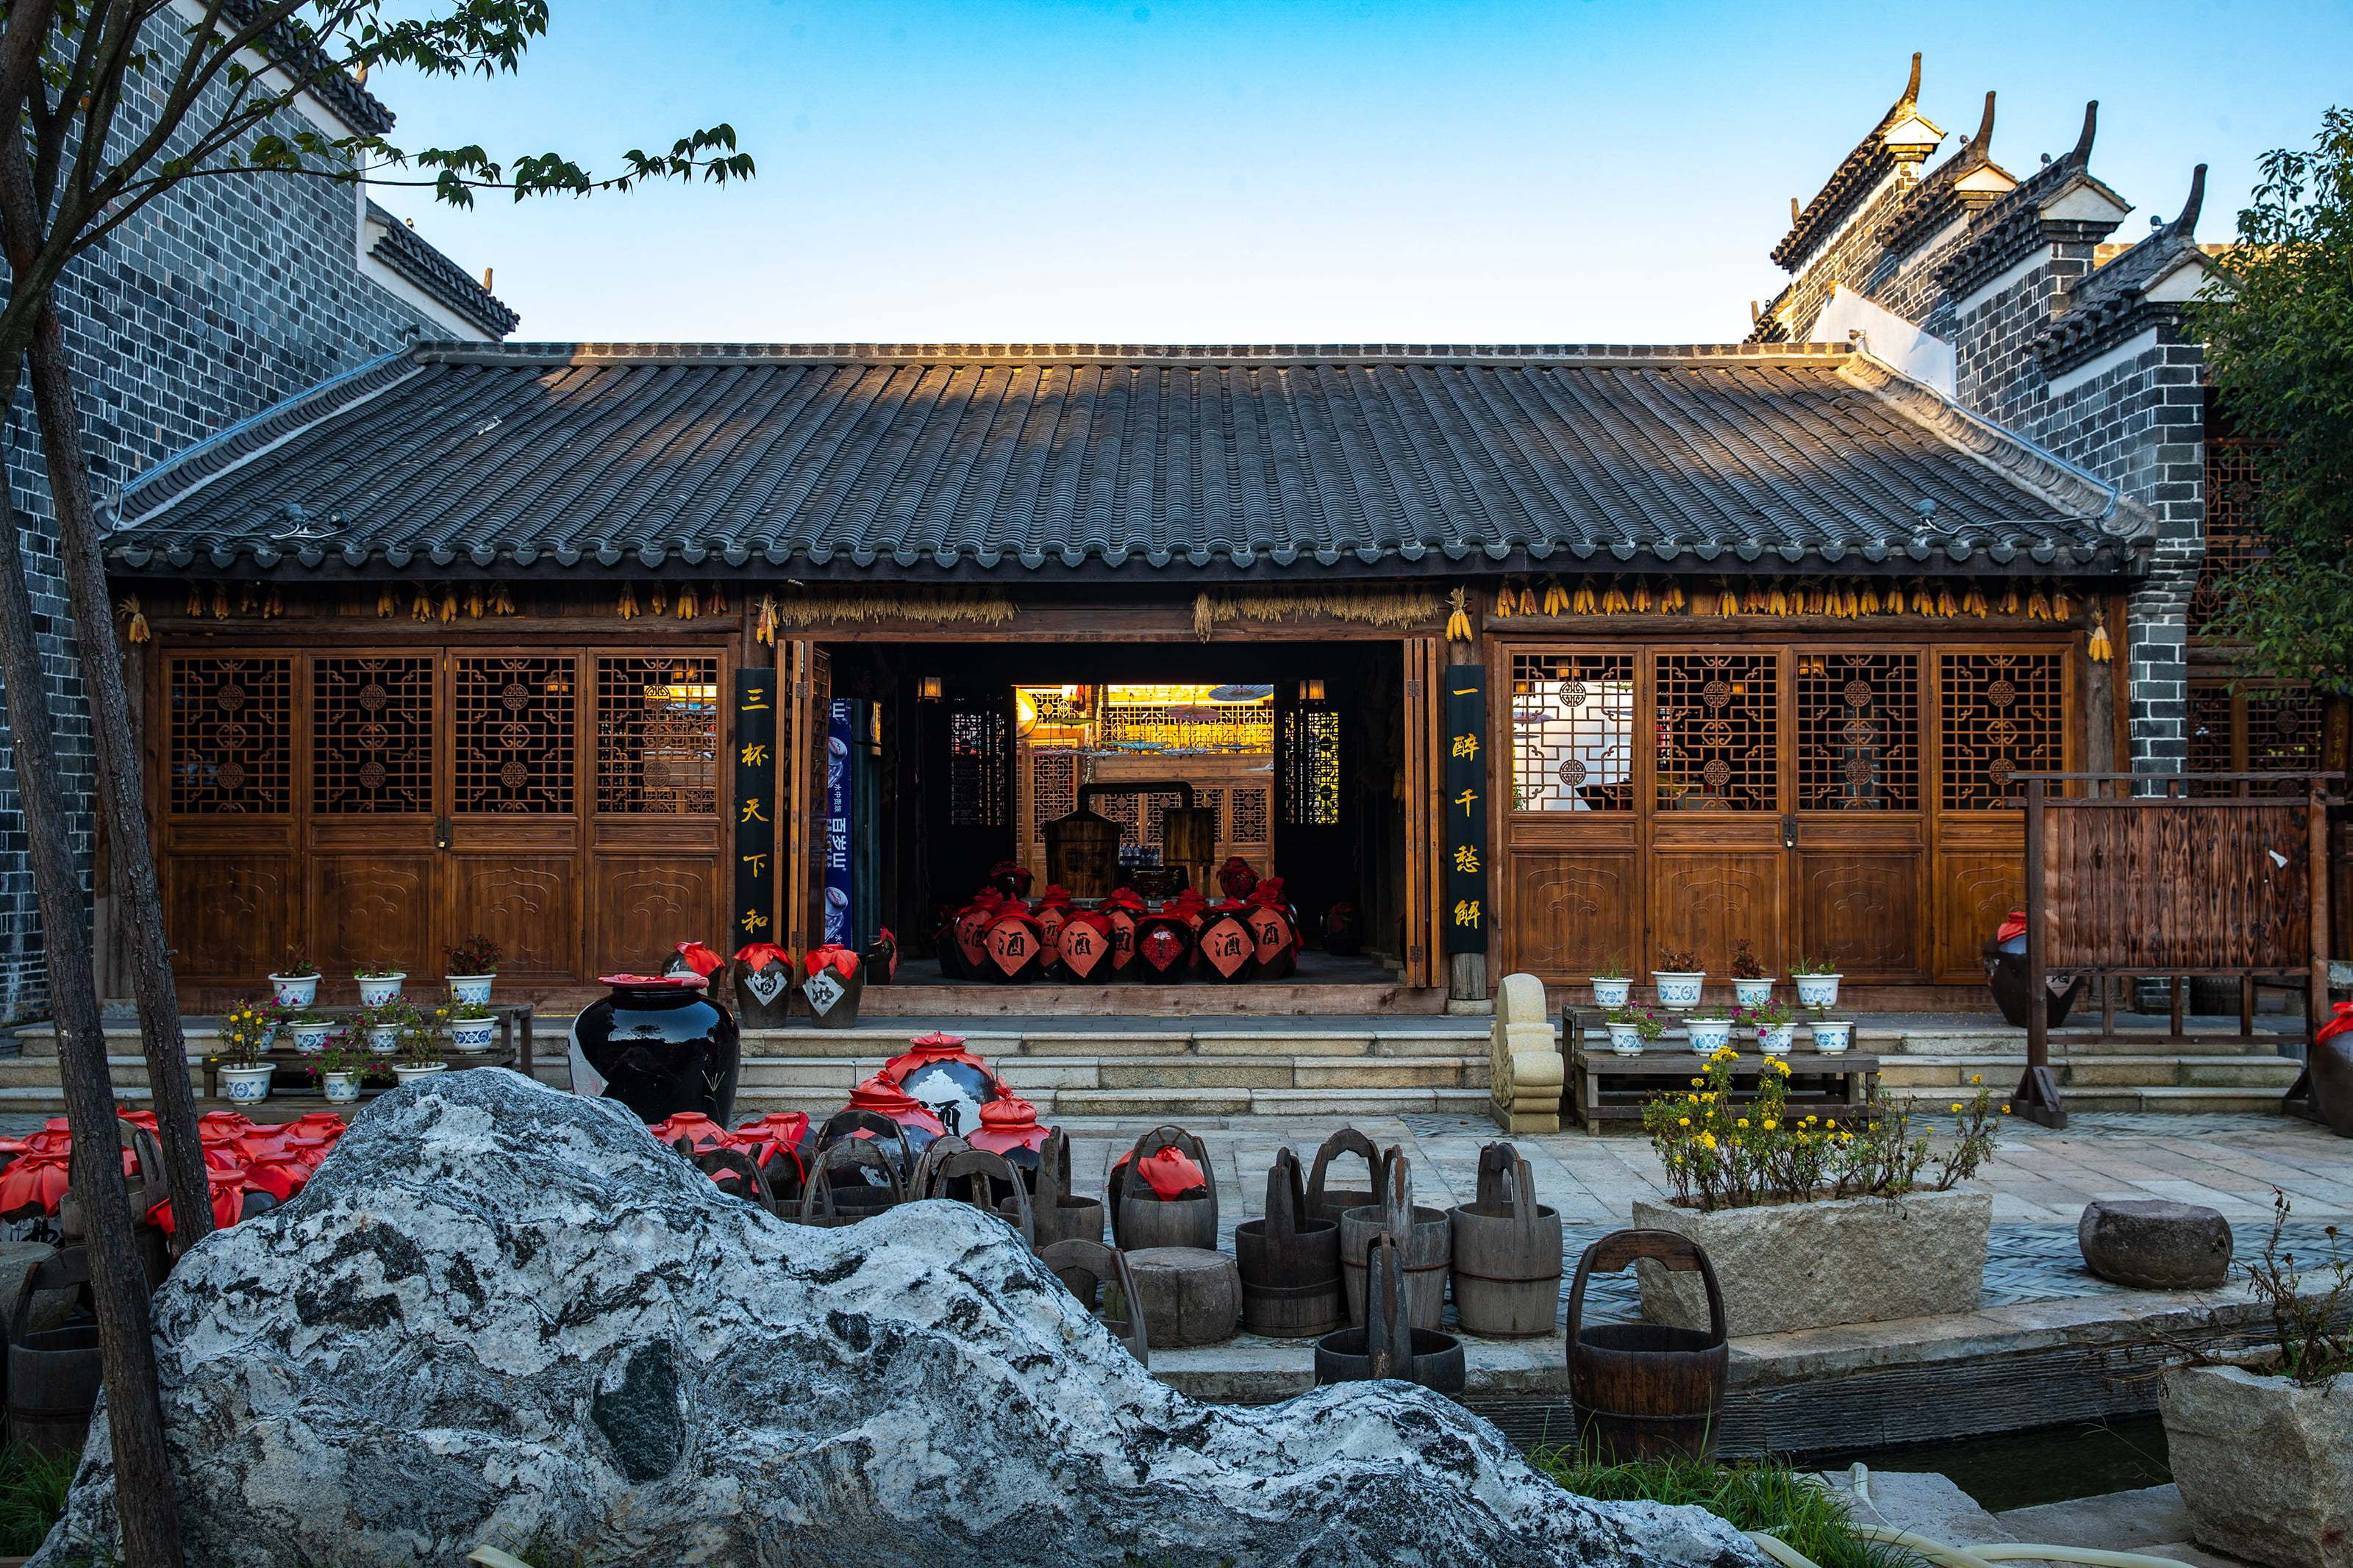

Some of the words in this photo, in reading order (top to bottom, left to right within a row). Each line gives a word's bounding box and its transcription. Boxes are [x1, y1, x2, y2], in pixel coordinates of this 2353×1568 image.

[741, 688, 769, 934] 三杯天下和
[834, 784, 842, 812] 水中贵族
[1452, 687, 1481, 930] 一醉千愁解
[832, 817, 846, 869] 百岁山
[996, 929, 1025, 957] 酒
[1067, 931, 1092, 956] 酒
[1215, 931, 1242, 957] 酒
[1254, 921, 1279, 946] 酒
